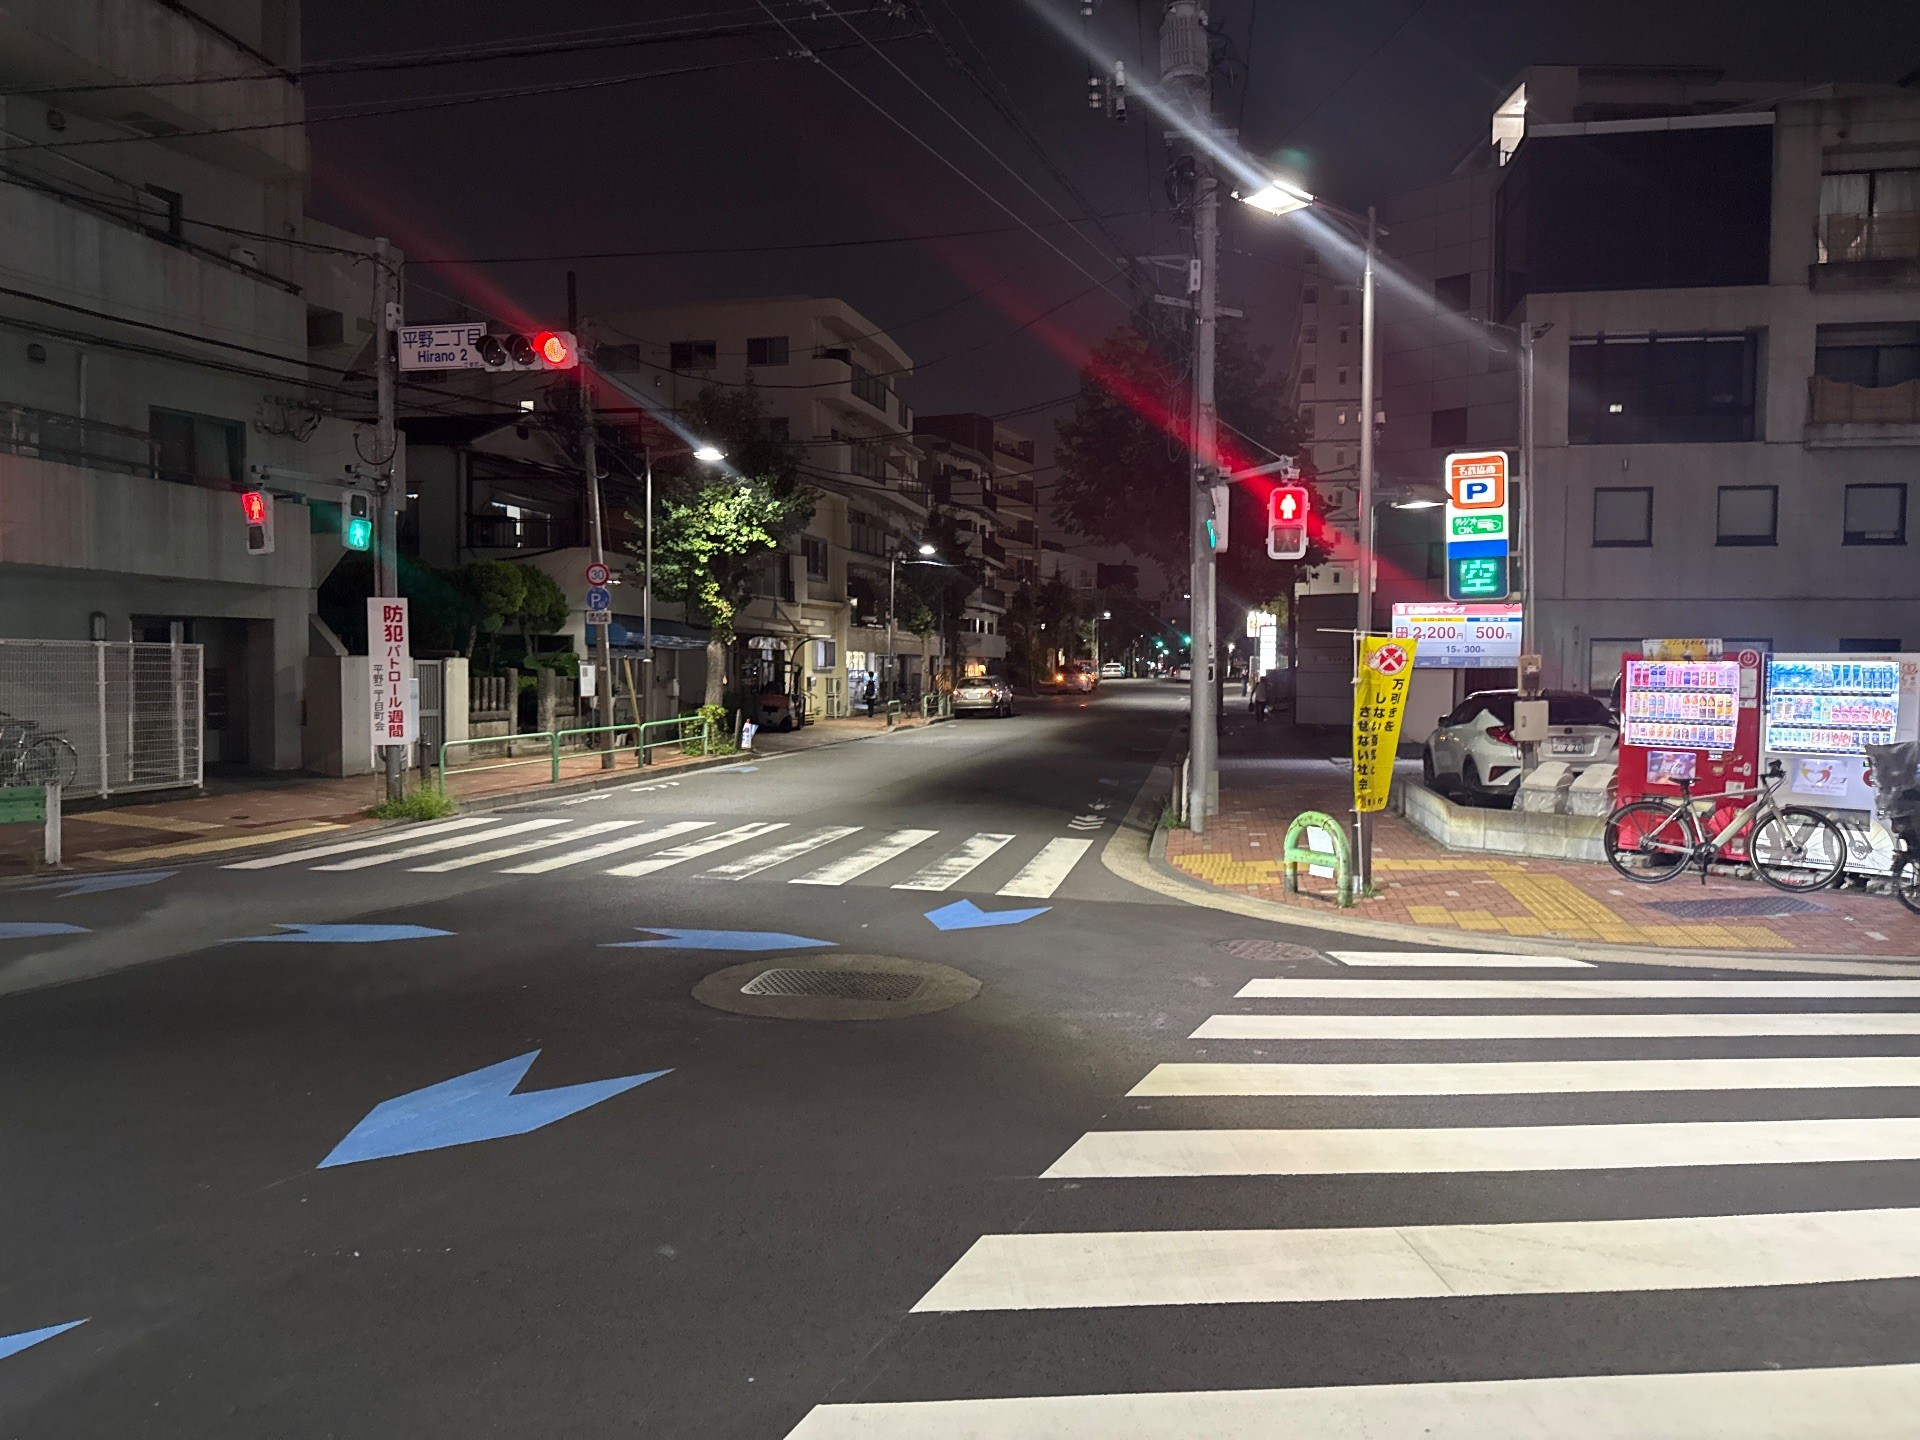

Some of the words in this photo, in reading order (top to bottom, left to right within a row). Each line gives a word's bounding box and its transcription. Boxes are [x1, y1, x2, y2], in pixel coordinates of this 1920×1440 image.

[402, 328, 482, 349] 平野二丁目
[417, 350, 456, 363] Hirano
[460, 349, 468, 362] 2
[1466, 482, 1488, 500] P
[1457, 526, 1474, 534] OK
[590, 569, 605, 580] 30
[1461, 559, 1495, 592] 空
[590, 593, 601, 608] P
[1476, 626, 1512, 639] 500円
[383, 605, 404, 738] 防犯パトロール週間
[372, 664, 385, 731] 平野二丁目町会
[1384, 678, 1405, 732] 万引きを
[1357, 706, 1371, 790] させない社会
